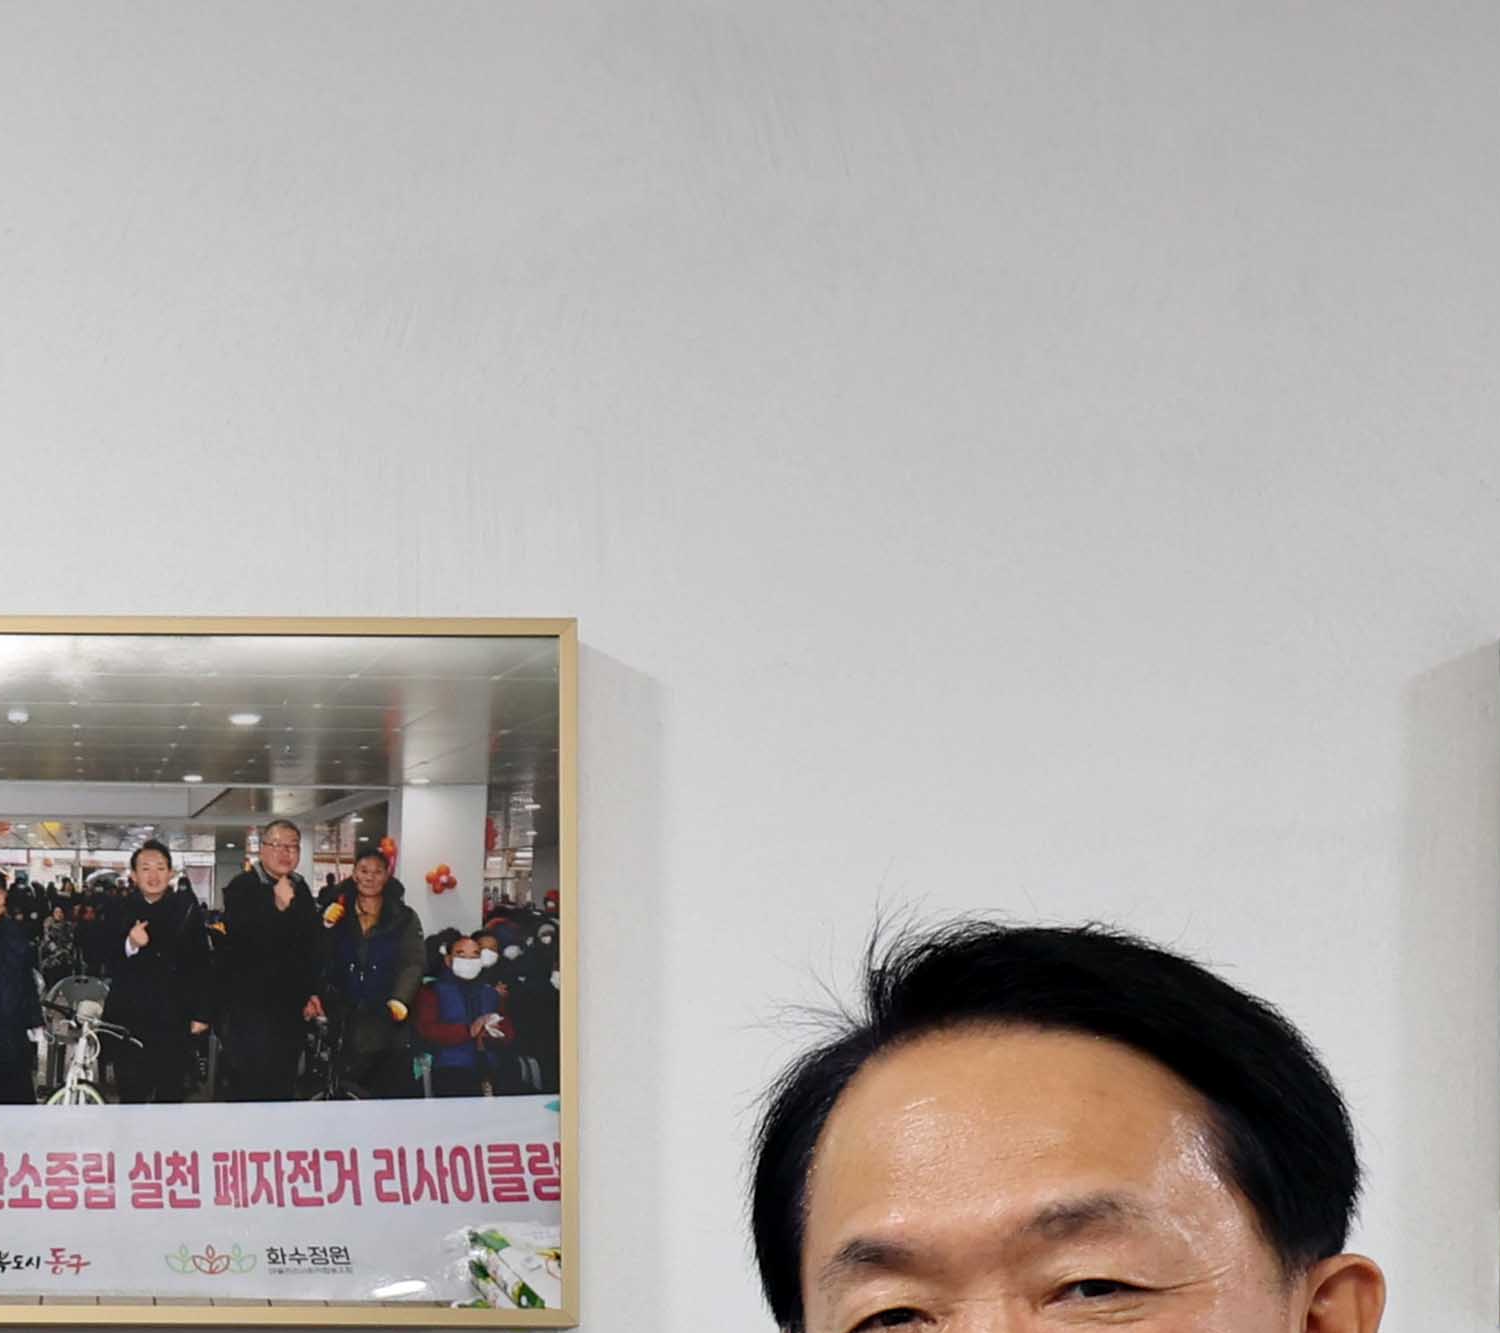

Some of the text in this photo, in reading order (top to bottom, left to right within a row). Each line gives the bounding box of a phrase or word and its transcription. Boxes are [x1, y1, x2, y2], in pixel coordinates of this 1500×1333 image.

[128, 1149, 202, 1209] 실천
[212, 1147, 363, 1209] 폐자전거
[44, 1247, 92, 1276] 동구
[265, 1245, 352, 1265] 화수정원
